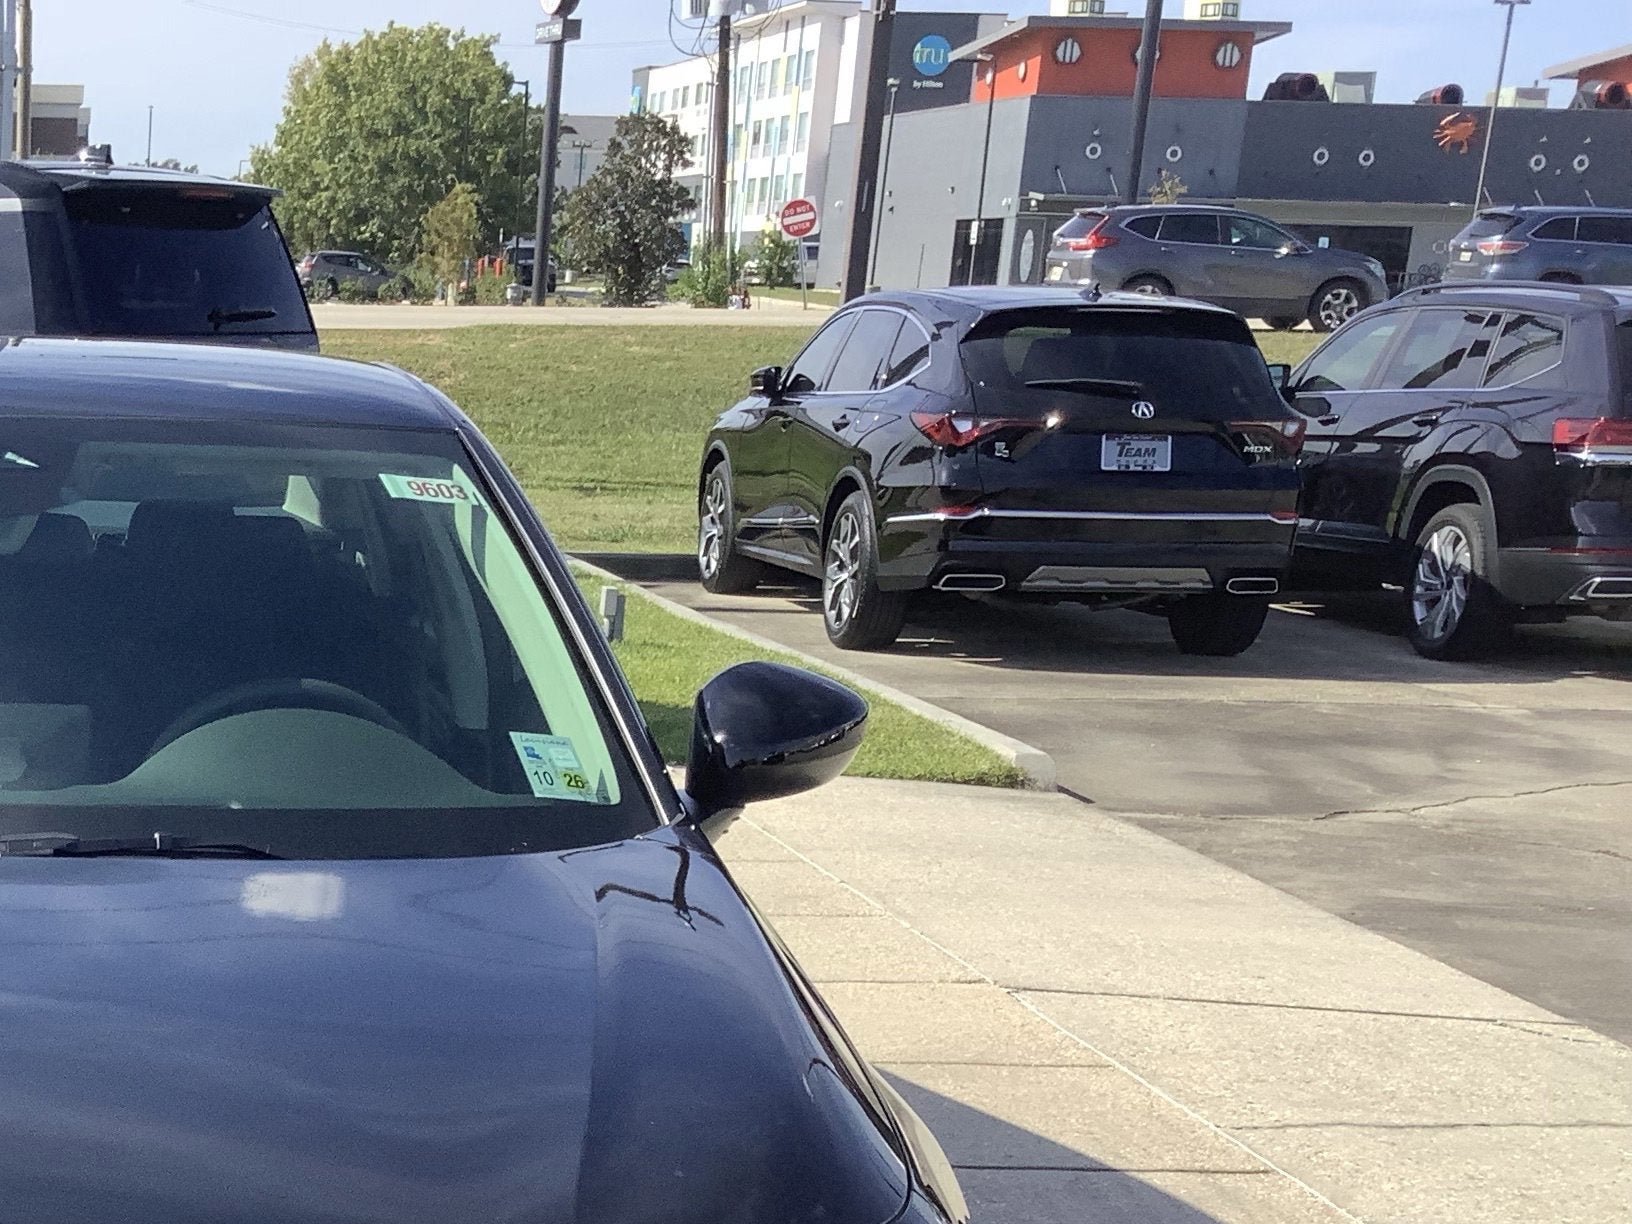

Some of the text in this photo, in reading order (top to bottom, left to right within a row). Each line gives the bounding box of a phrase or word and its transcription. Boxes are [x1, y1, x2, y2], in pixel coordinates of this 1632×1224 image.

[784, 204, 810, 216] DO NOT
[789, 221, 811, 233] ENTER
[1116, 441, 1157, 458] TEAM
[1243, 445, 1273, 453] MDX
[407, 480, 470, 501] 9603
[533, 770, 585, 789] 10 26
